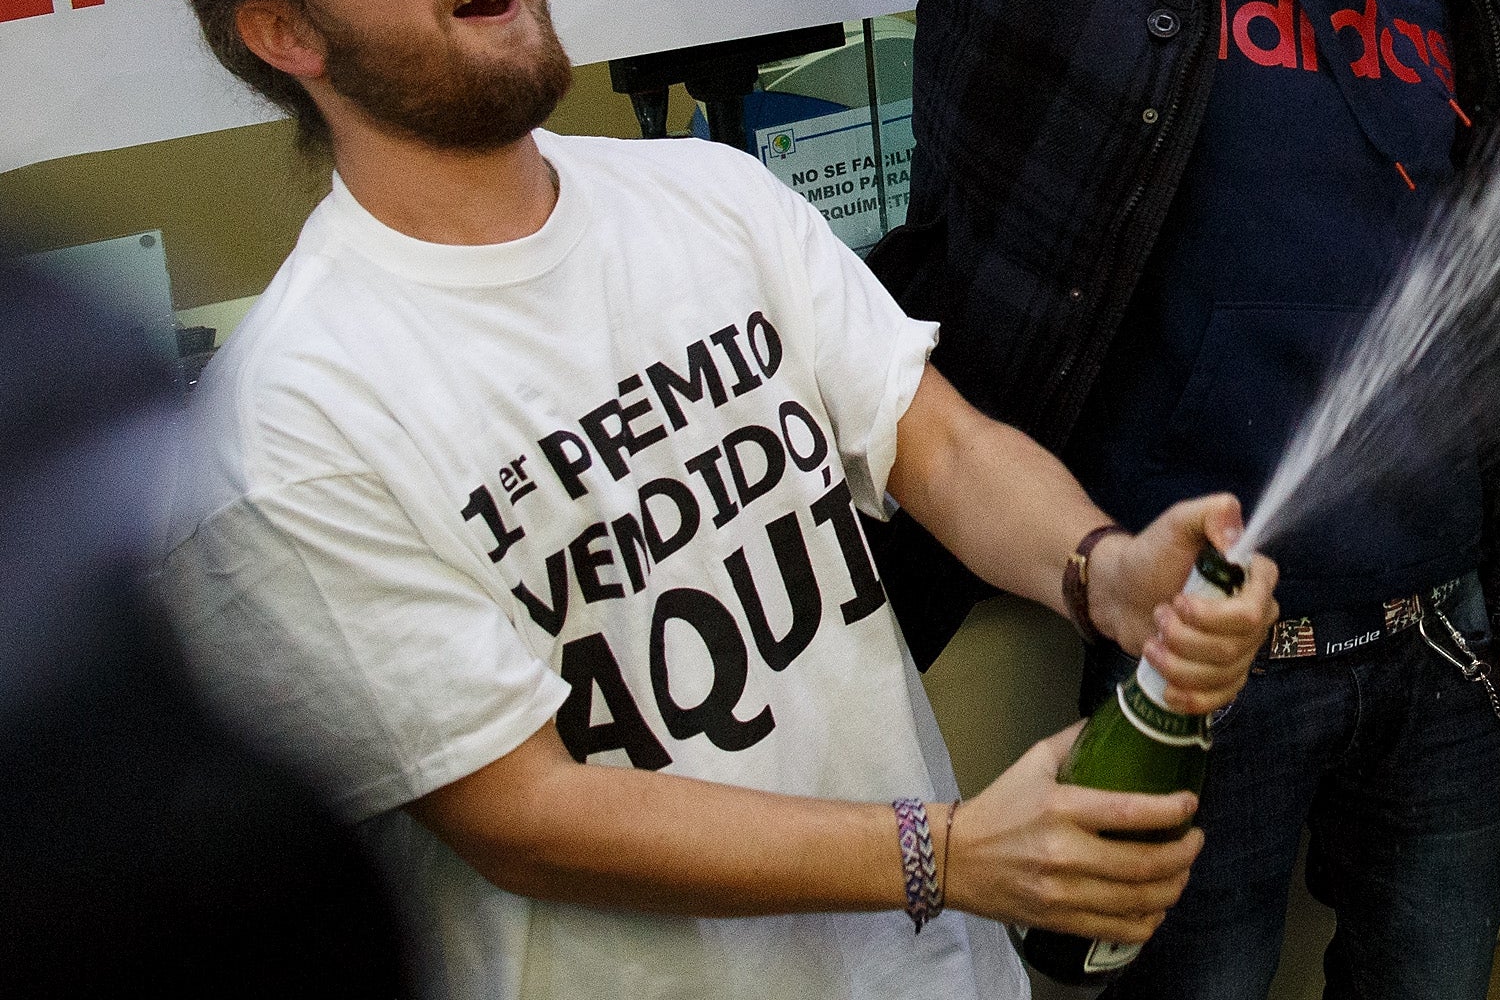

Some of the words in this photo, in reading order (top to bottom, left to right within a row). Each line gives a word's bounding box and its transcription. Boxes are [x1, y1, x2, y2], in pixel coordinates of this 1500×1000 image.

[792, 169, 819, 186] NO
[824, 161, 847, 178] SE
[801, 181, 854, 203] MBIO
[537, 311, 783, 500] PREMIO
[511, 400, 829, 638] VENDIDO
[554, 466, 888, 772] AQUÍ
[1326, 630, 1380, 655] Inside
